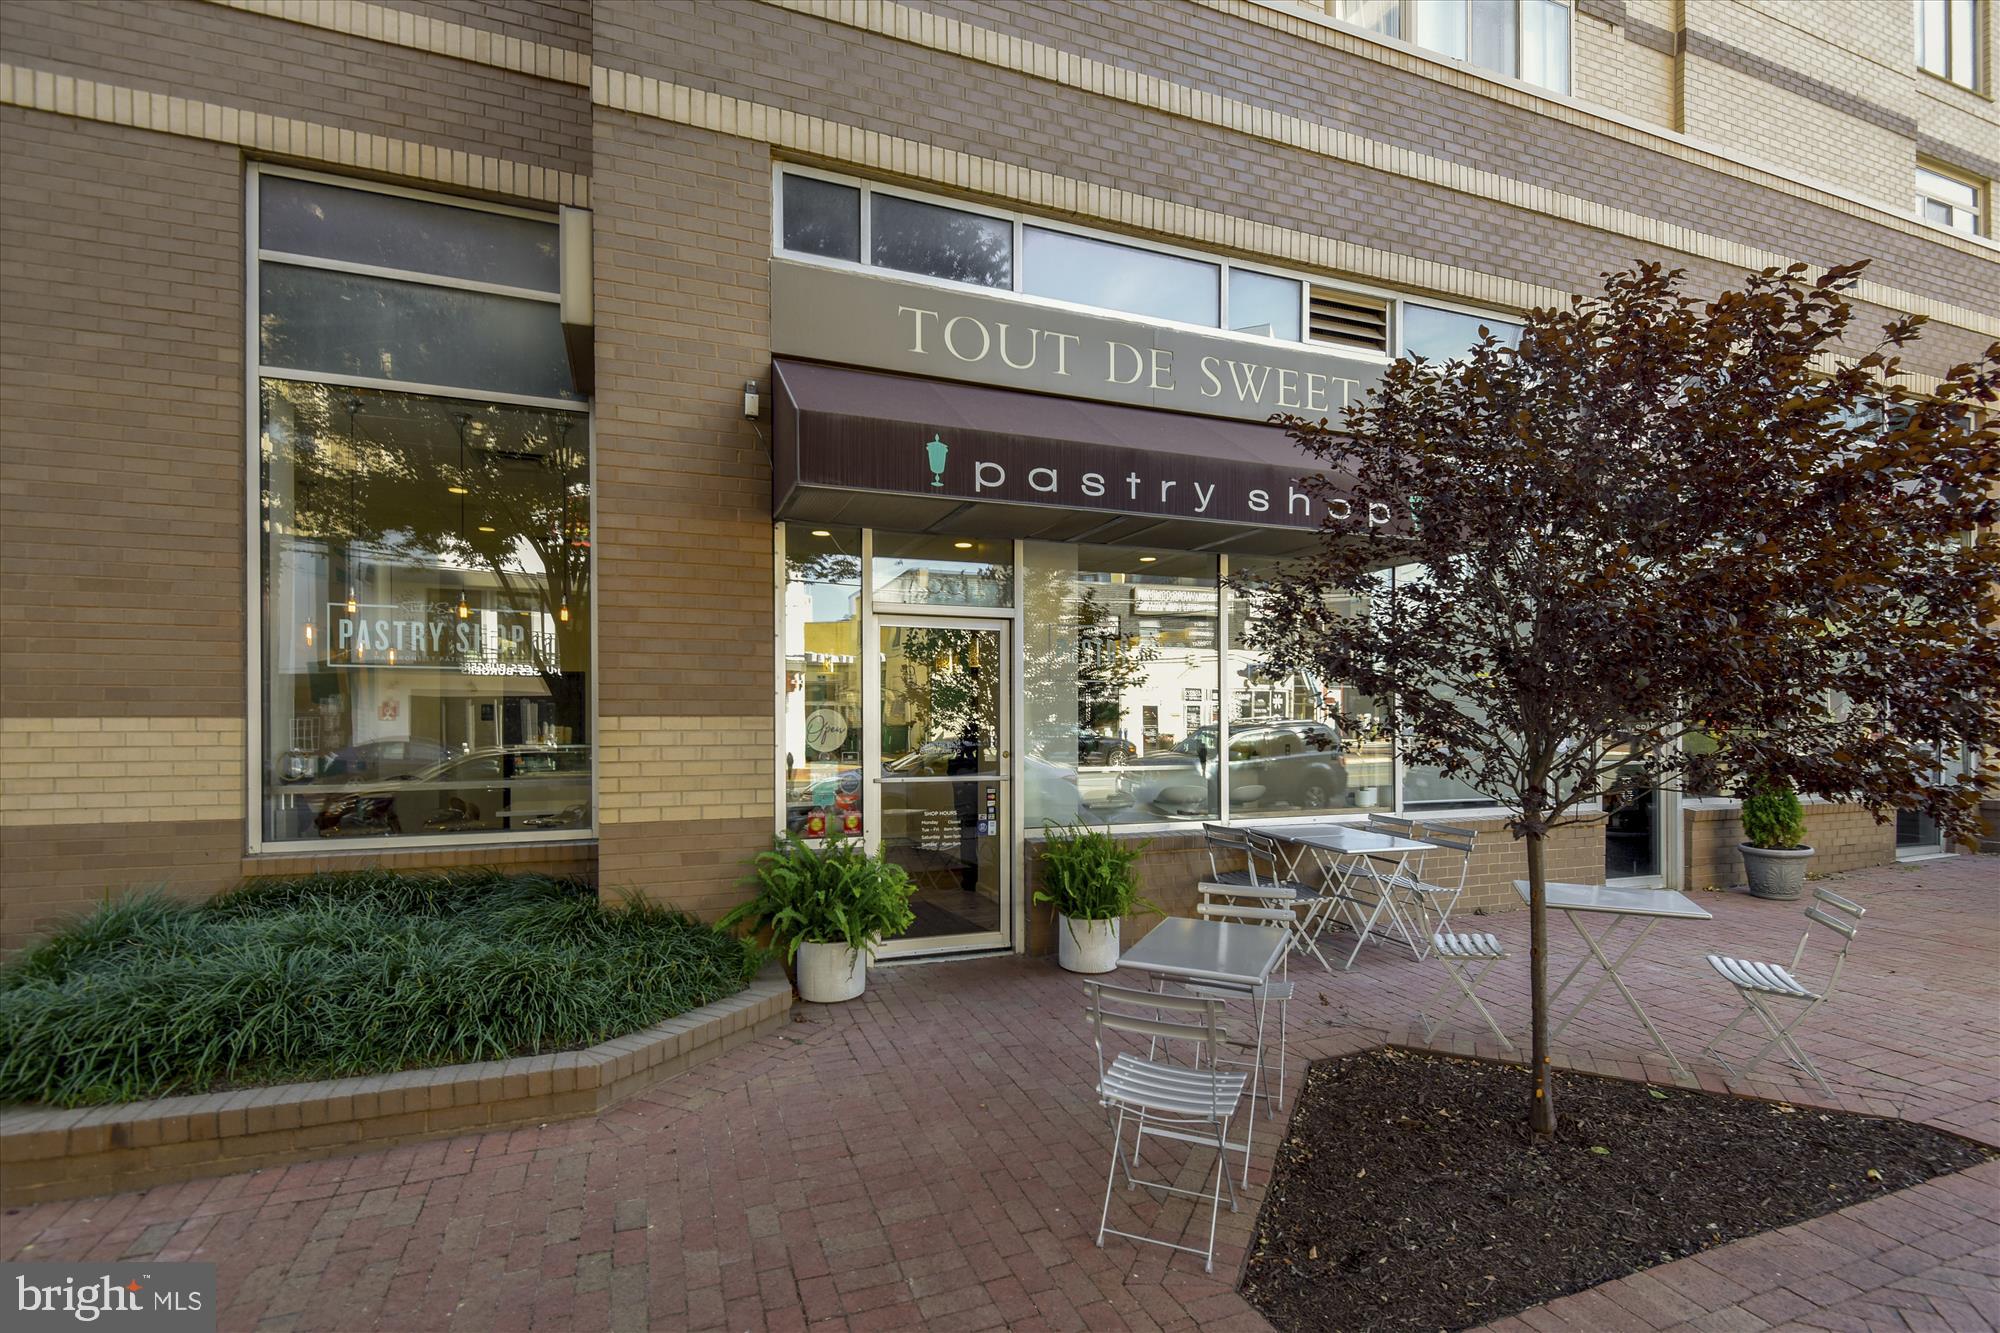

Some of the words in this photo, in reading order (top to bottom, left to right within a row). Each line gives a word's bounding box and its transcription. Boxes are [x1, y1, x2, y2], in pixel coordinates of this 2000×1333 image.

[897, 305, 1081, 375] TOUT
[1105, 341, 1176, 391] DE
[1200, 356, 1361, 414] SWEET
[974, 460, 1216, 513] pastry
[1248, 486, 1391, 528] shop
[338, 618, 446, 653] PASTRY
[806, 715, 846, 745] Open
